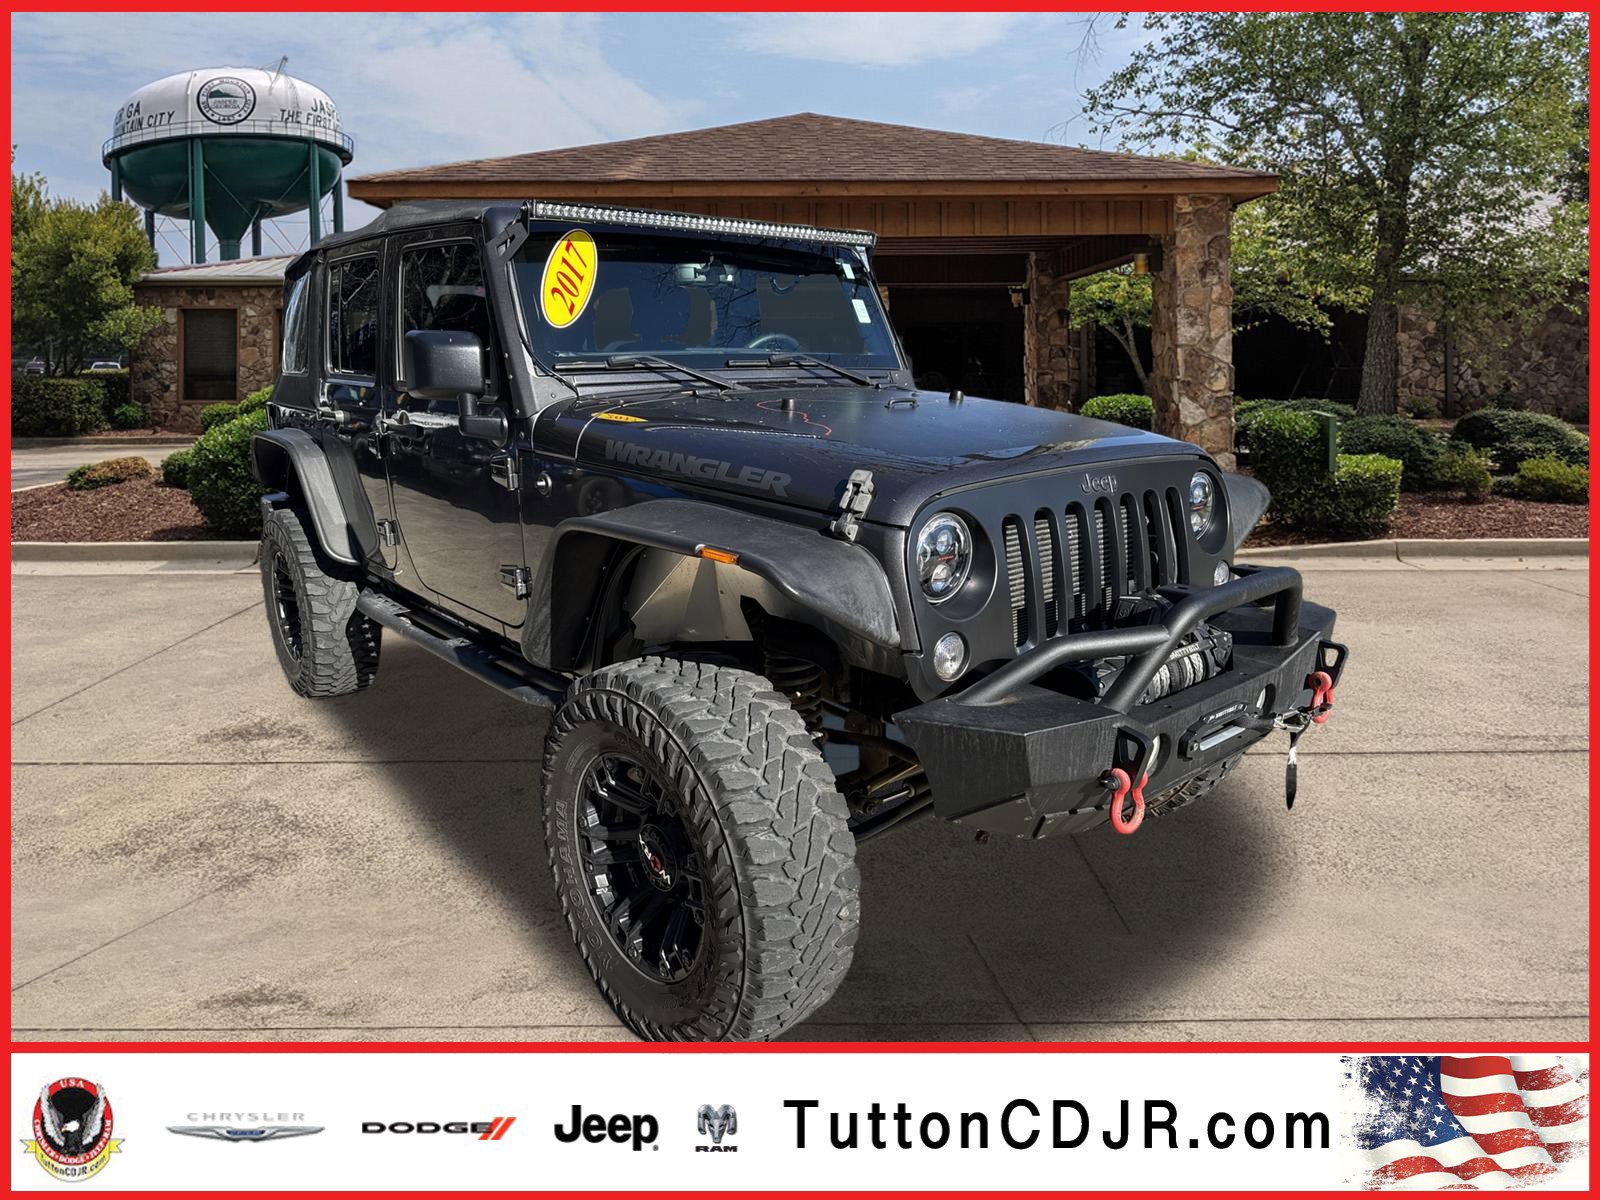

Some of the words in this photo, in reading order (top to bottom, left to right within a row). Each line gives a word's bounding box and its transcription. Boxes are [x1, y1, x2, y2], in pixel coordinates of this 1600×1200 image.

[126, 100, 141, 119] GA
[147, 110, 175, 128] CITY
[280, 108, 302, 124] THE
[551, 239, 587, 316] 2017
[604, 439, 792, 498] WRANGLER
[1080, 473, 1118, 494] Jeep
[555, 800, 612, 970] YOKOHAMA
